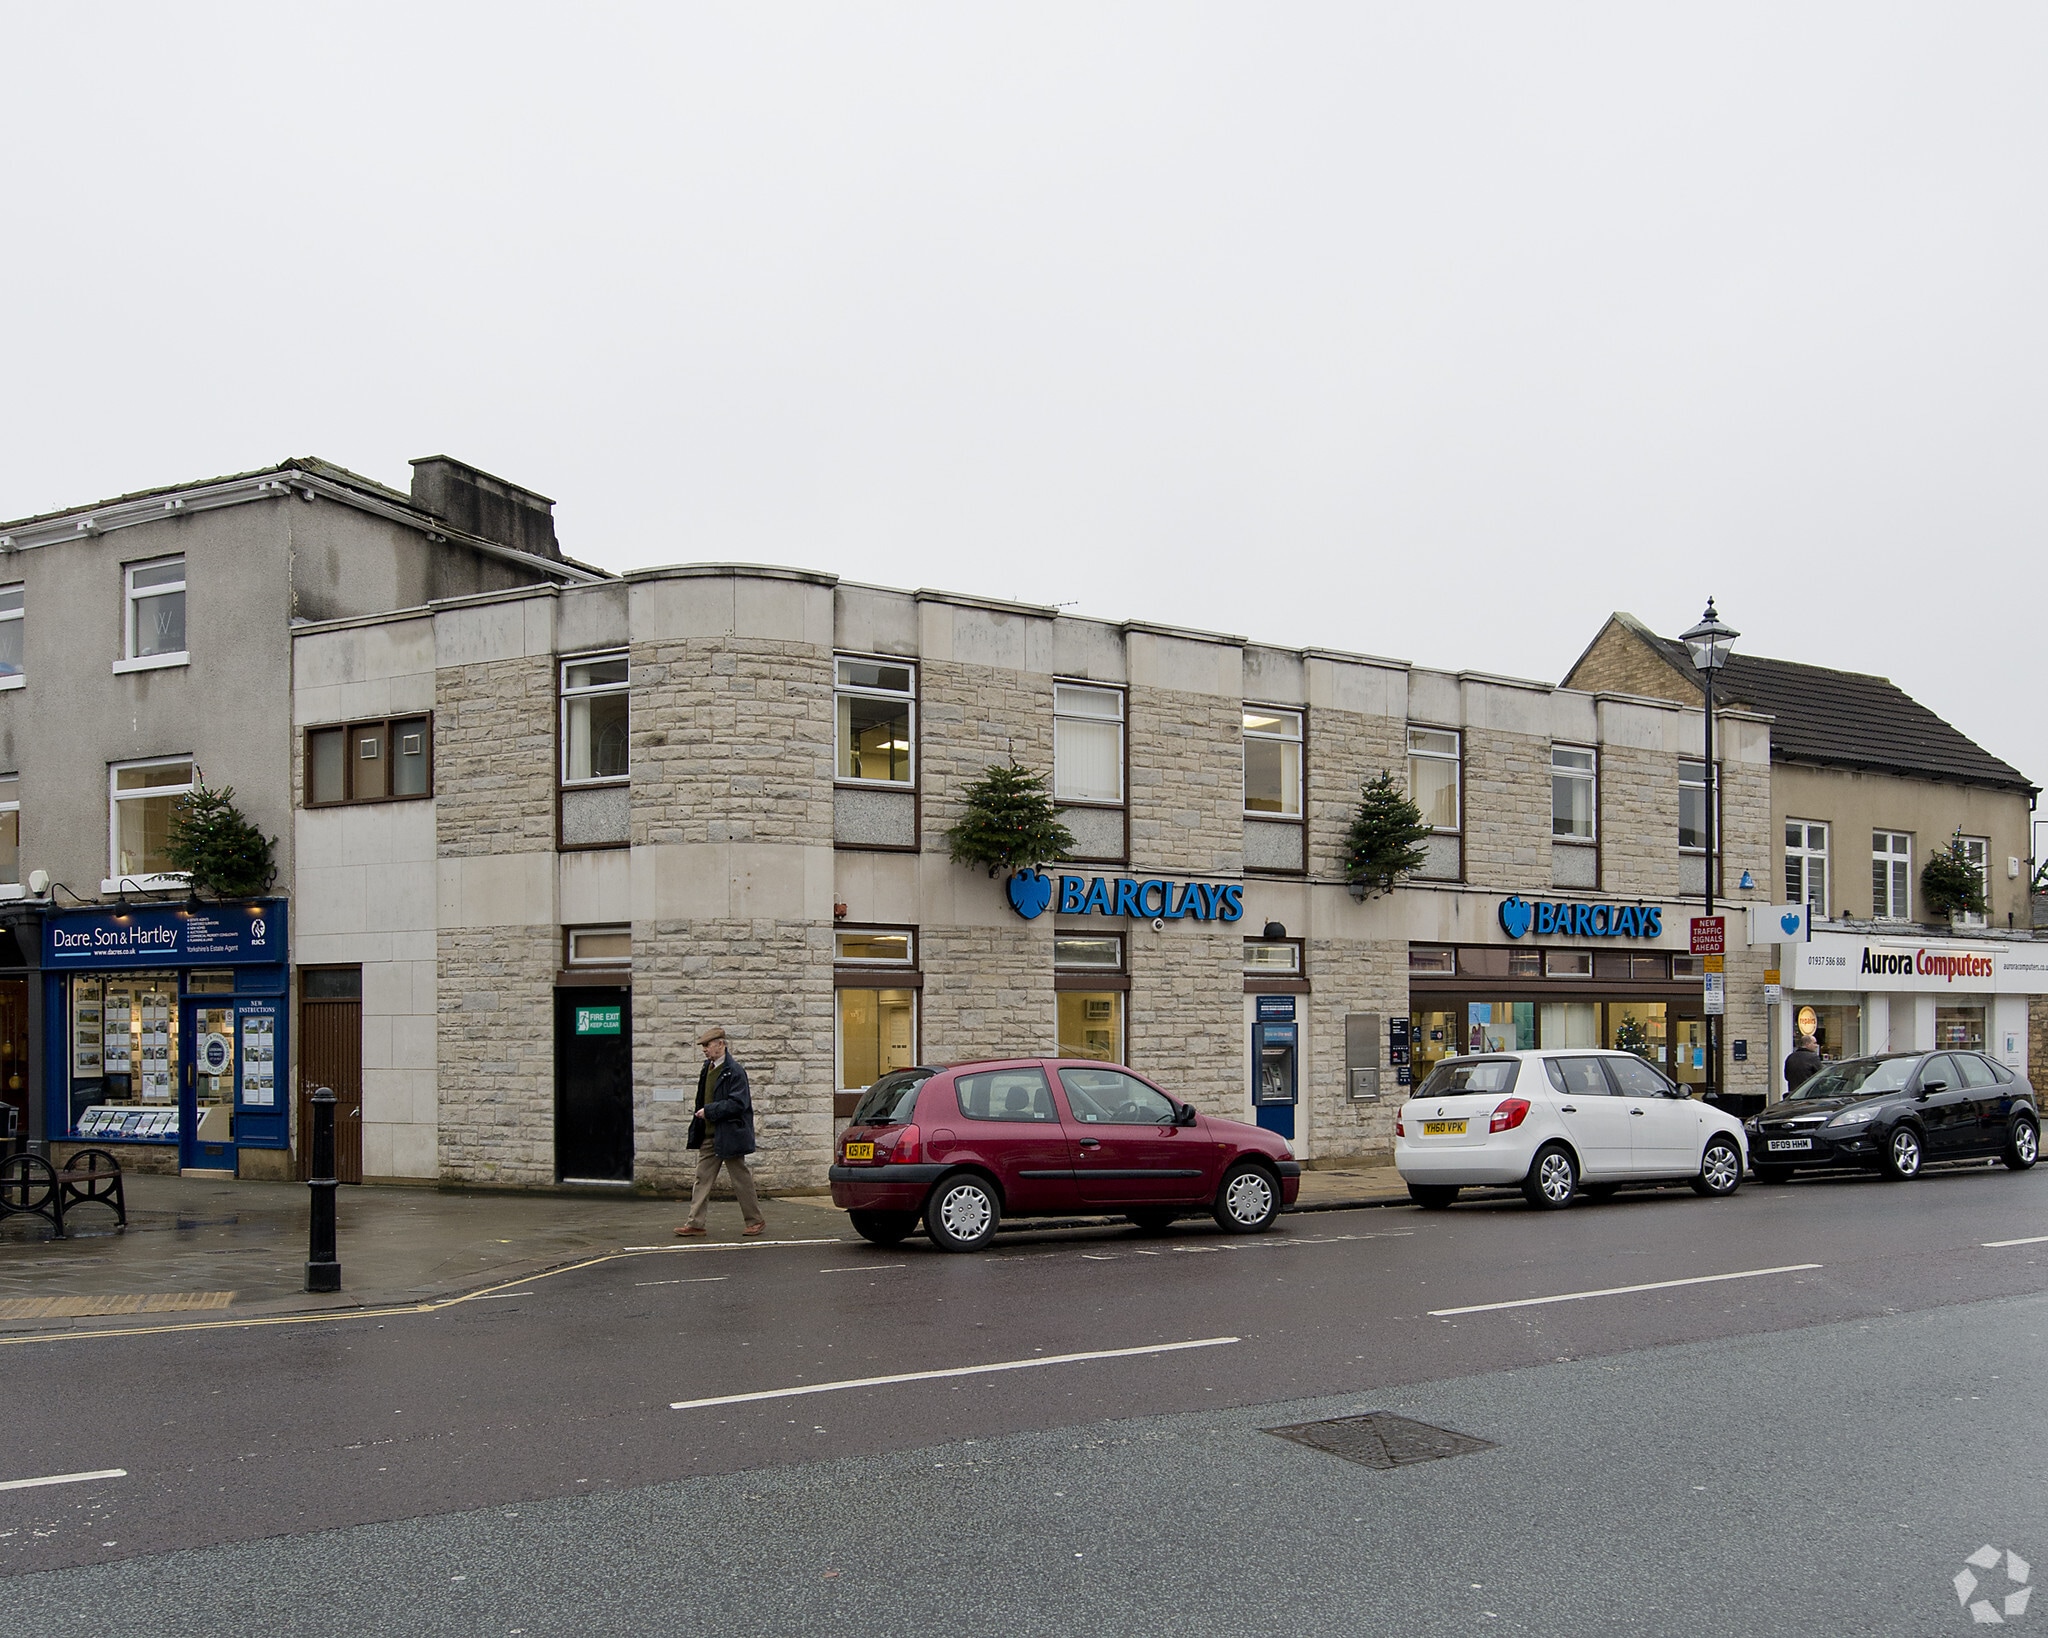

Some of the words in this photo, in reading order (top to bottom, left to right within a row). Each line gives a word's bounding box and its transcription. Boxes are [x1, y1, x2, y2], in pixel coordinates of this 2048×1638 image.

[1058, 875, 1244, 922] BARCLAYS
[1533, 902, 1663, 938] BARCLAYS
[1700, 919, 1716, 927] NEW
[1693, 927, 1722, 935] TRAFFIC
[54, 929, 93, 947] Dacre,
[94, 927, 119, 946] Son
[120, 931, 127, 945] &
[130, 925, 178, 947] Hartley
[1692, 935, 1723, 943] SIGNALS
[93, 948, 136, 956] www.dacres.co.uk
[1808, 956, 1824, 965] 01937
[1825, 957, 1835, 966] 586
[1836, 957, 1846, 966] 888
[1861, 947, 1913, 974] Aurora
[1916, 948, 1993, 983] Computers
[590, 1013, 604, 1021] FIRE
[1426, 1122, 1445, 1132] YH60
[1447, 1121, 1463, 1131] VPK
[1771, 1141, 1790, 1149] BF09
